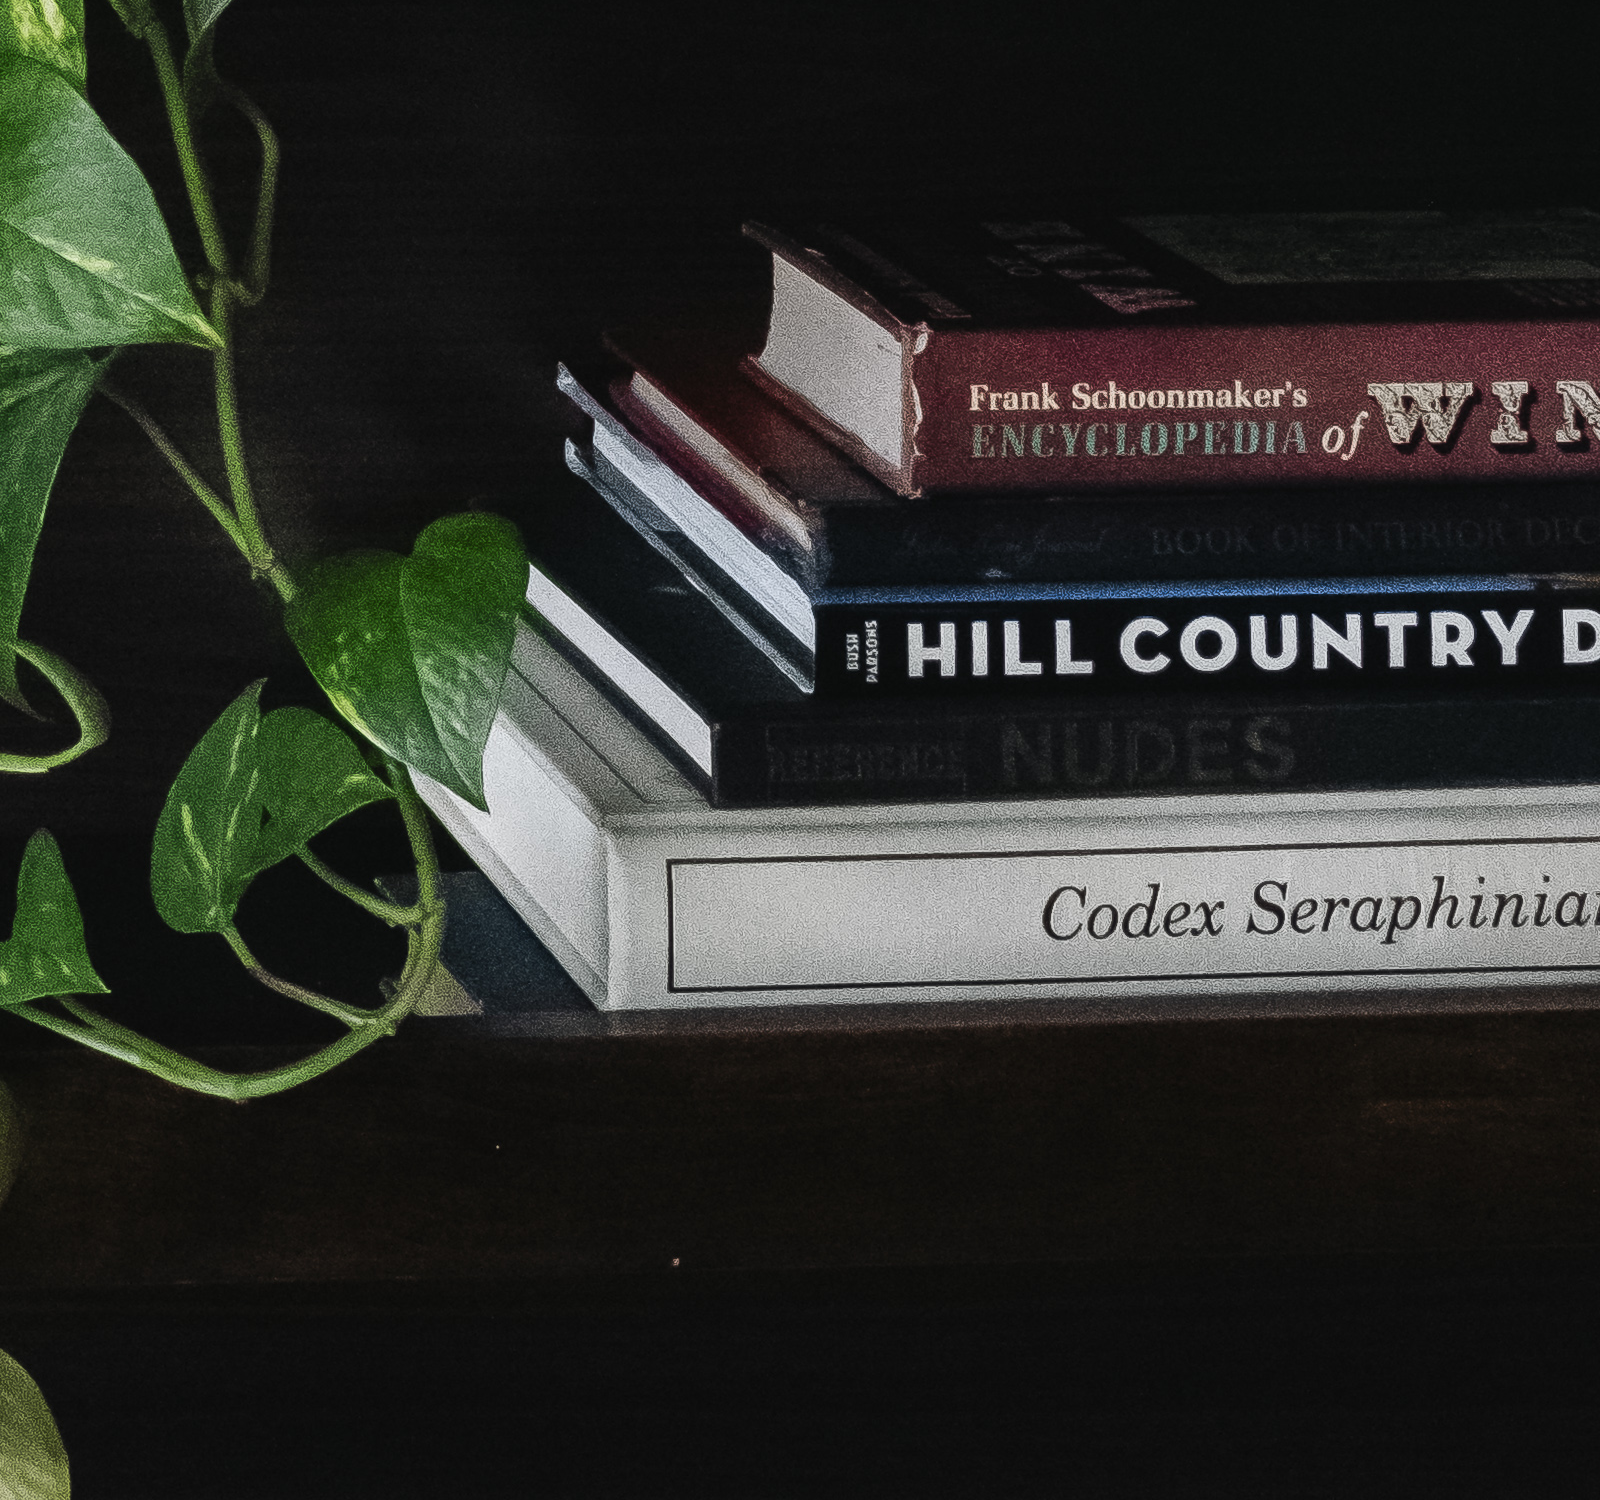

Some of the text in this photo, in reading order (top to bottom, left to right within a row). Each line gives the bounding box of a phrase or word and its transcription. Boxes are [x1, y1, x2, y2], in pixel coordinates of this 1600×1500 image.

[970, 380, 1308, 412] Frank Schoonmaker's
[970, 418, 1308, 459] ENCYCLOPEDIA
[1321, 411, 1369, 462] of
[1151, 526, 1255, 556] BOOK
[1272, 523, 1324, 553] OF
[1334, 518, 1507, 552] INTERIOR
[846, 633, 860, 671] BUSH
[865, 620, 879, 683] PARSONS
[906, 619, 1095, 678] HILL
[1120, 608, 1535, 674] COUNTRY
[1000, 714, 1297, 788] NUDES
[1042, 875, 1600, 945] Codex Seraphinia
